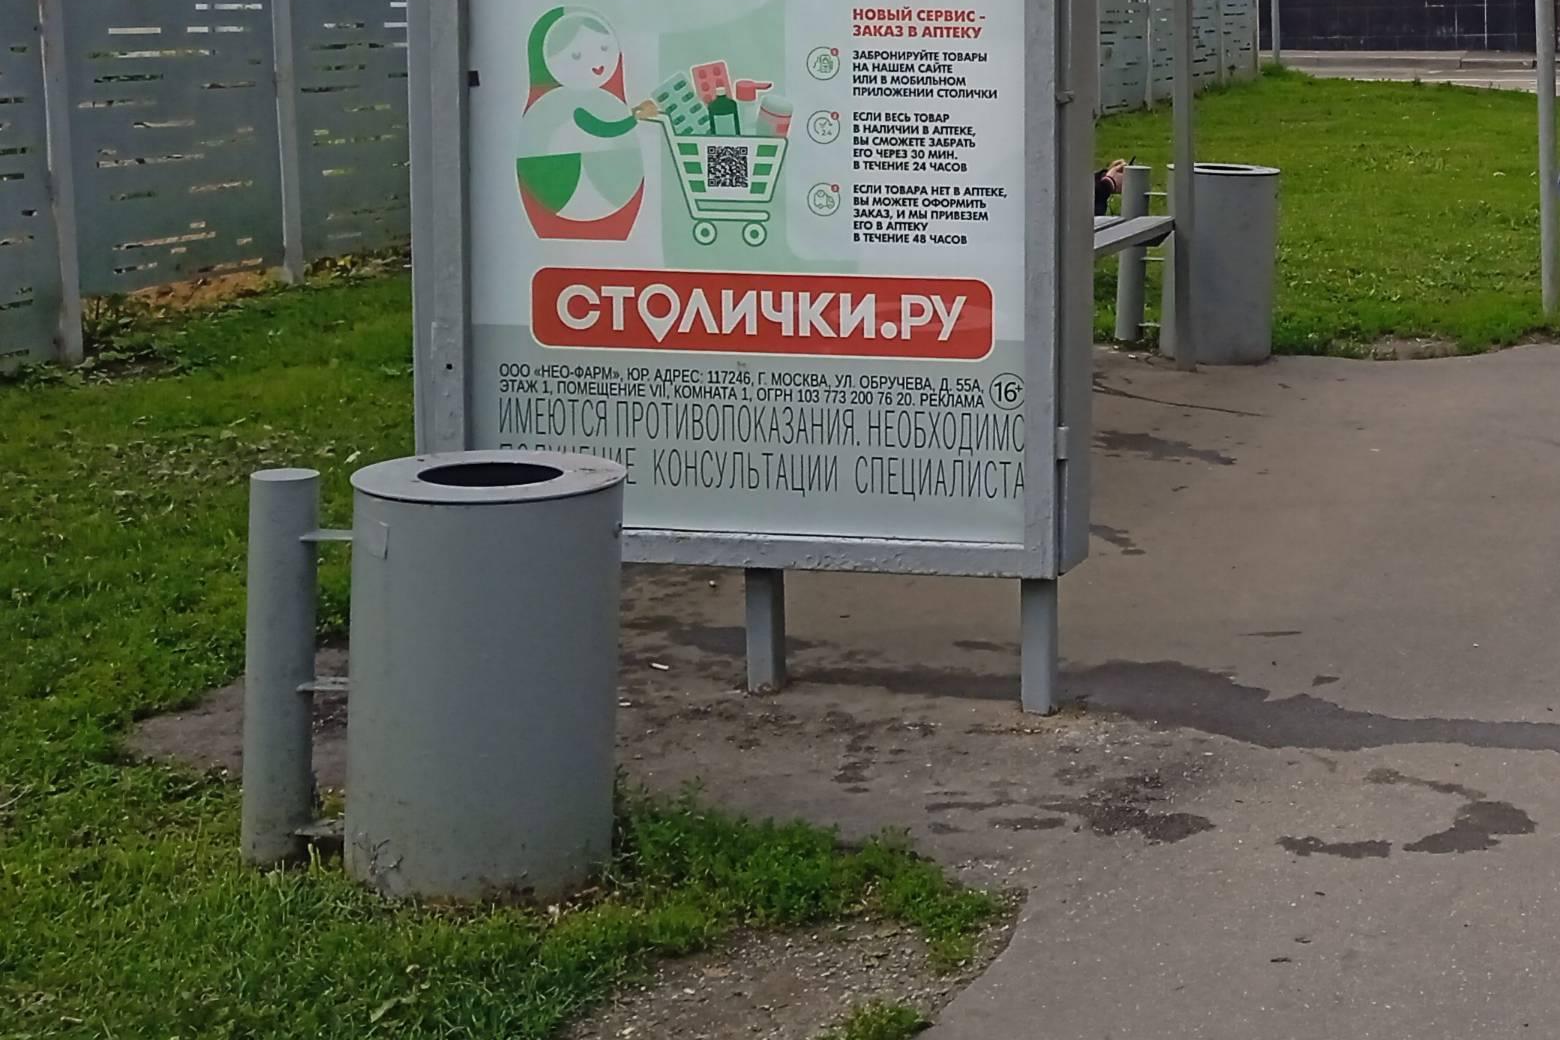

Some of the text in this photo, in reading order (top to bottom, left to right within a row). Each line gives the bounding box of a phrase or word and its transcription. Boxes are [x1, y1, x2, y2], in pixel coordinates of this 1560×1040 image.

[853, 6, 912, 21] НОВЫЙ
[917, 10, 975, 22] СЕРВИС
[853, 25, 982, 39] ЗАКАЗ В АПТЕКУ
[853, 50, 987, 62] ЗАБРОНИРУЙТЕ ТОВАРЫ
[853, 62, 952, 73] НА НАШЕМ САЙТЕ
[853, 75, 966, 86] ИЛИ В МОБИЛЬНОМ
[853, 87, 998, 99] ПРИЛОЖЕНИИ СТОЛИЧКИ
[853, 112, 949, 122] ЕСЛИ ВЕСЬ ТОВАР
[853, 125, 976, 137] В НАЛИЧИИ В АПТЕКЕ,
[853, 137, 976, 148] ВЫ СМОЖЕТЕ ЗАБРАТЬ
[853, 149, 958, 160] ЕГО ЧЕРЕЗ 30 МИН.
[853, 161, 967, 172] В ТЕЧЕНИЕ 24 ЧАСОВ
[853, 184, 1007, 198] ЕСЛИ ТОВАРА НЕТ В АПТЕКЕ,
[853, 197, 986, 209] ВЫ МОЖЕТЕ ОФОРМИТЬ
[853, 209, 988, 221] ЗАКАЗ, И МЫ ПРИВЕЗЕМ
[853, 221, 929, 232] ЕГО В АПТЕКУ
[853, 233, 967, 244] В ТЕЧЕНИЕ 48 ЧАСОВ
[556, 283, 967, 343] СТОЛИЧКИ.РУ
[500, 364, 530, 377] ООО
[627, 367, 649, 381] ЮР.
[654, 369, 703, 385] АДРЕС:
[707, 371, 754, 386] 117246,
[758, 372, 767, 385] Г.
[771, 372, 831, 389] МОСКВА,
[835, 374, 855, 388] УЛ.
[859, 375, 935, 393] ОБРУЧЕВА,
[939, 378, 952, 394] Д.
[956, 378, 984, 393] 55А,
[500, 379, 985, 408] ЭТАЖ 1, ПОМЕЩЕНИЕ VII, КОМНАТА 1, ОГРН 103 773 200 76 20. РЕКЛАМА
[500, 397, 607, 437] ИМЕЮТСЯ
[616, 400, 860, 447] ПРОТИВОПОКАЗАНИЯ.
[653, 448, 838, 497] КОНСУЛЬТАЦИИ
[855, 456, 1024, 501] СПЕЦИАЛИСТА
